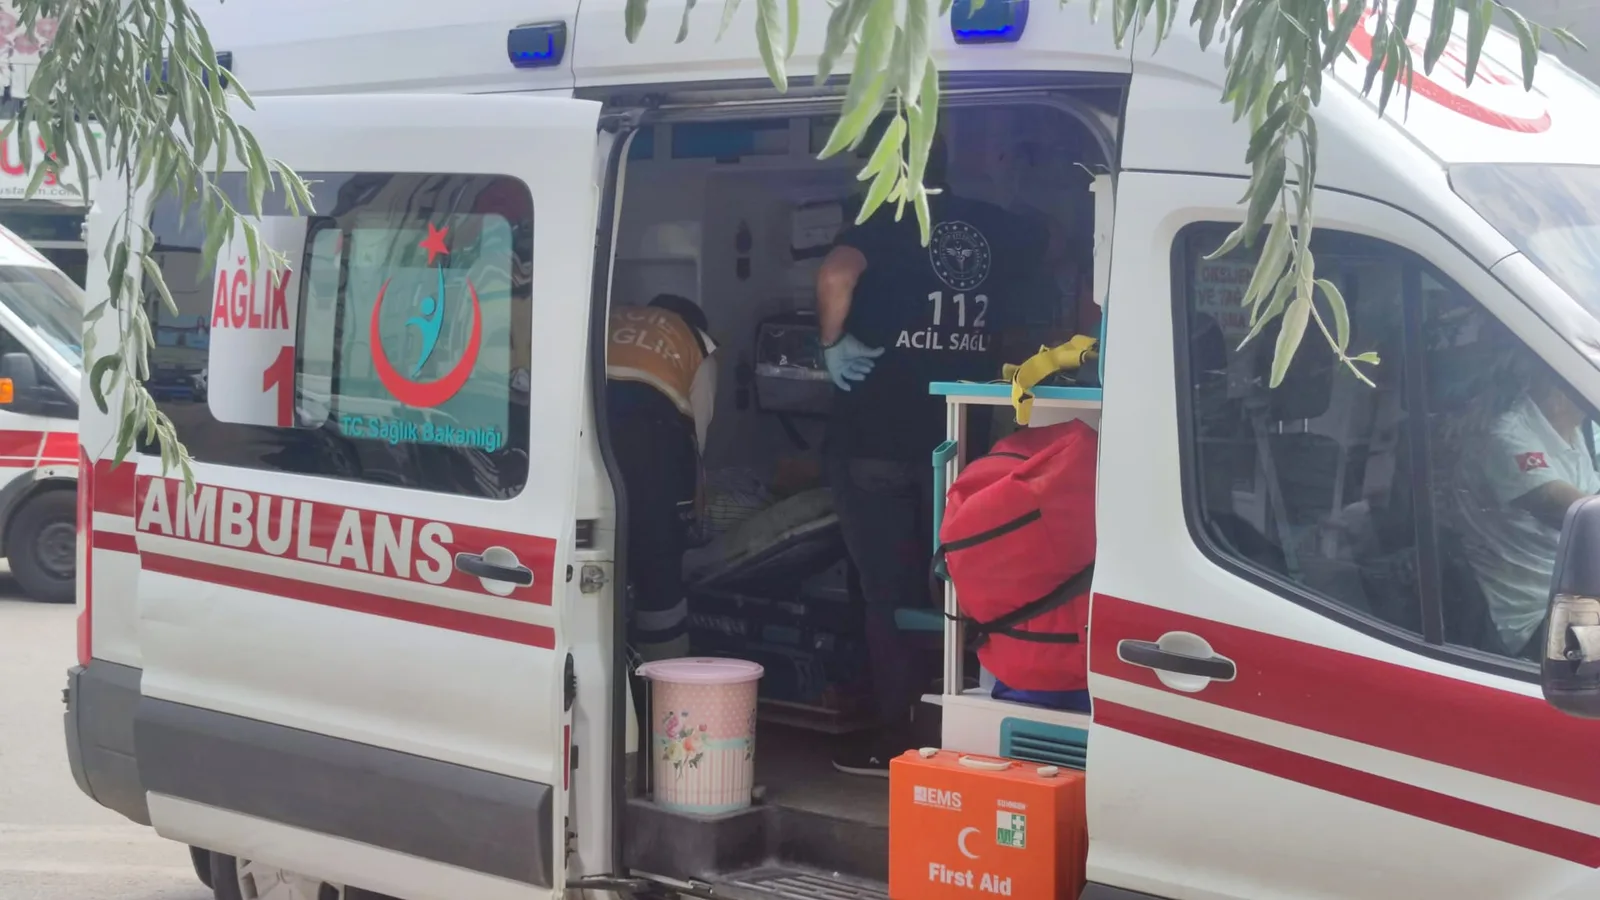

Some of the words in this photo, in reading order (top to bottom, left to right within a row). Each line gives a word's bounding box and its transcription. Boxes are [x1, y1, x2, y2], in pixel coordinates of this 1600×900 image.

[895, 327, 943, 350] ACİL
[263, 345, 295, 427] 1
[369, 416, 418, 445] Sağlık
[422, 421, 502, 453] Bakanlığı
[137, 477, 454, 585] AMBULANS
[927, 787, 962, 808] EMS
[929, 862, 974, 889] First
[980, 873, 1012, 896] Aid
